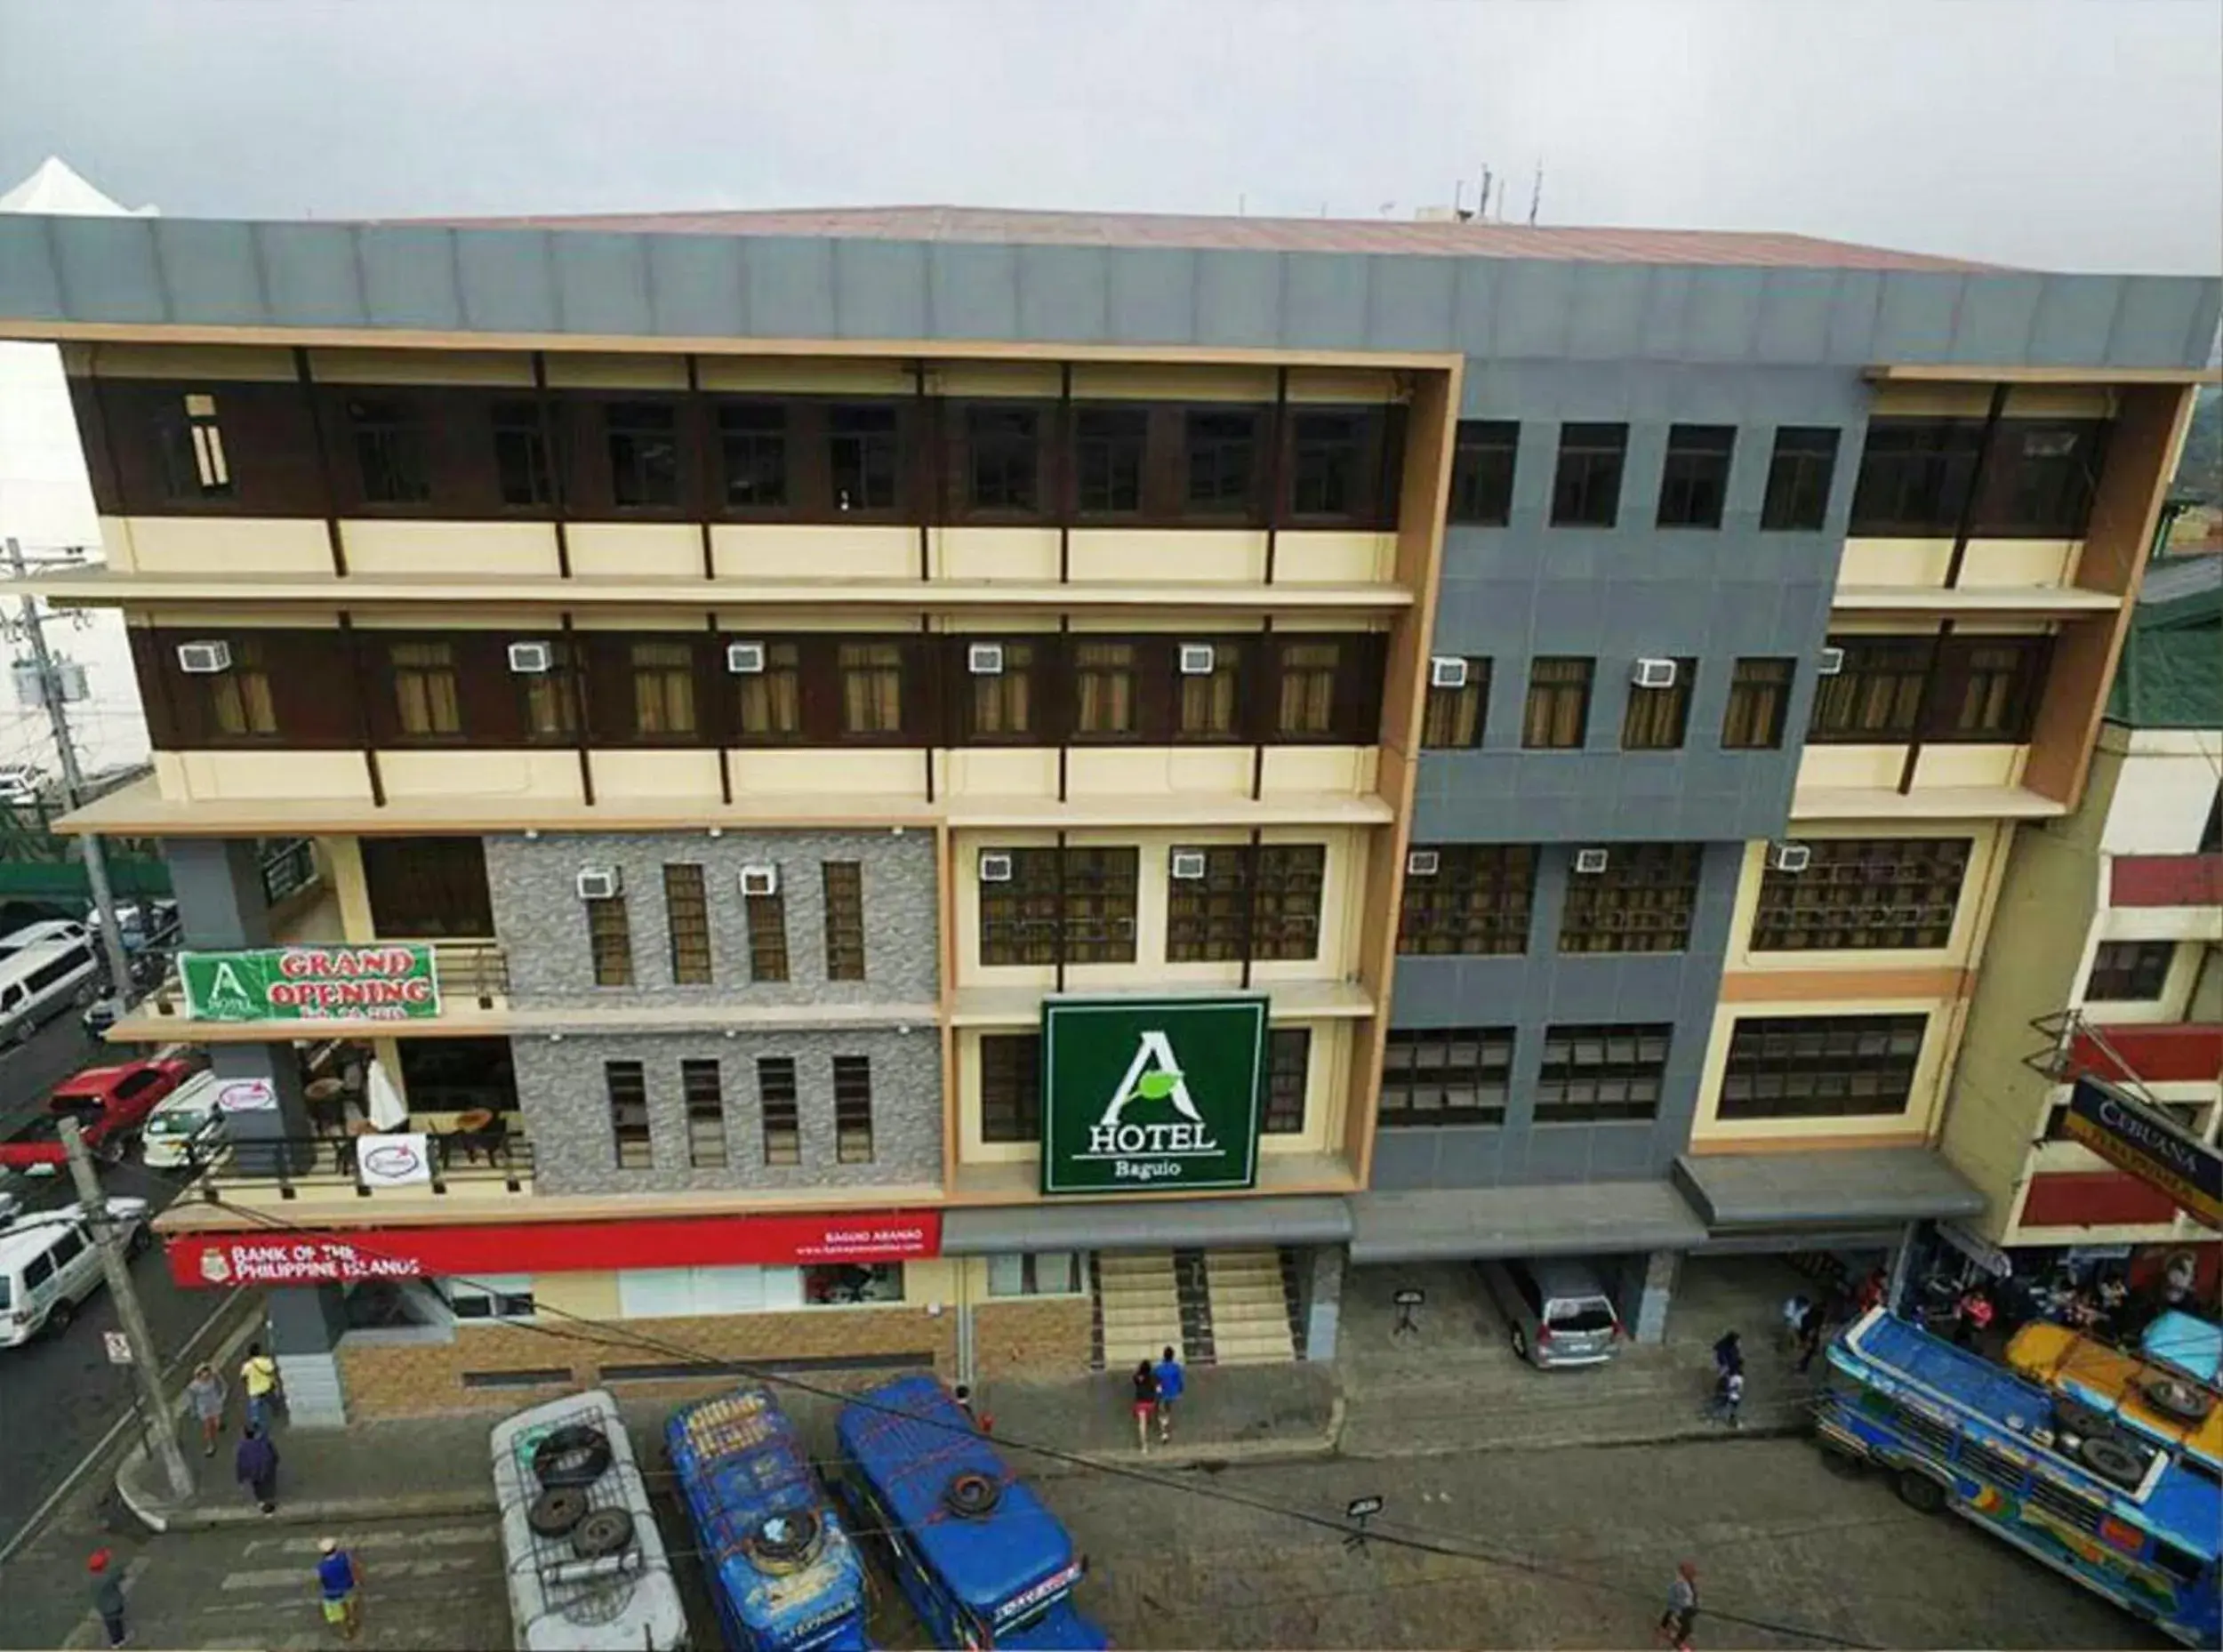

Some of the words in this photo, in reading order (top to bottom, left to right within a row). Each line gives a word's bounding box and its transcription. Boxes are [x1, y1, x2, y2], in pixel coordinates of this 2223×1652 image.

[279, 948, 415, 977] GRAND
[211, 962, 248, 998] A
[268, 977, 429, 1006] OPENING
[1100, 1030, 1202, 1126] A
[1088, 1122, 1217, 1152] HOTEL
[1114, 1160, 1183, 1180] Baguio
[231, 1246, 286, 1263] BANK
[293, 1246, 317, 1261] OF
[321, 1245, 355, 1261] THE
[235, 1261, 339, 1279] PHILIPPINE
